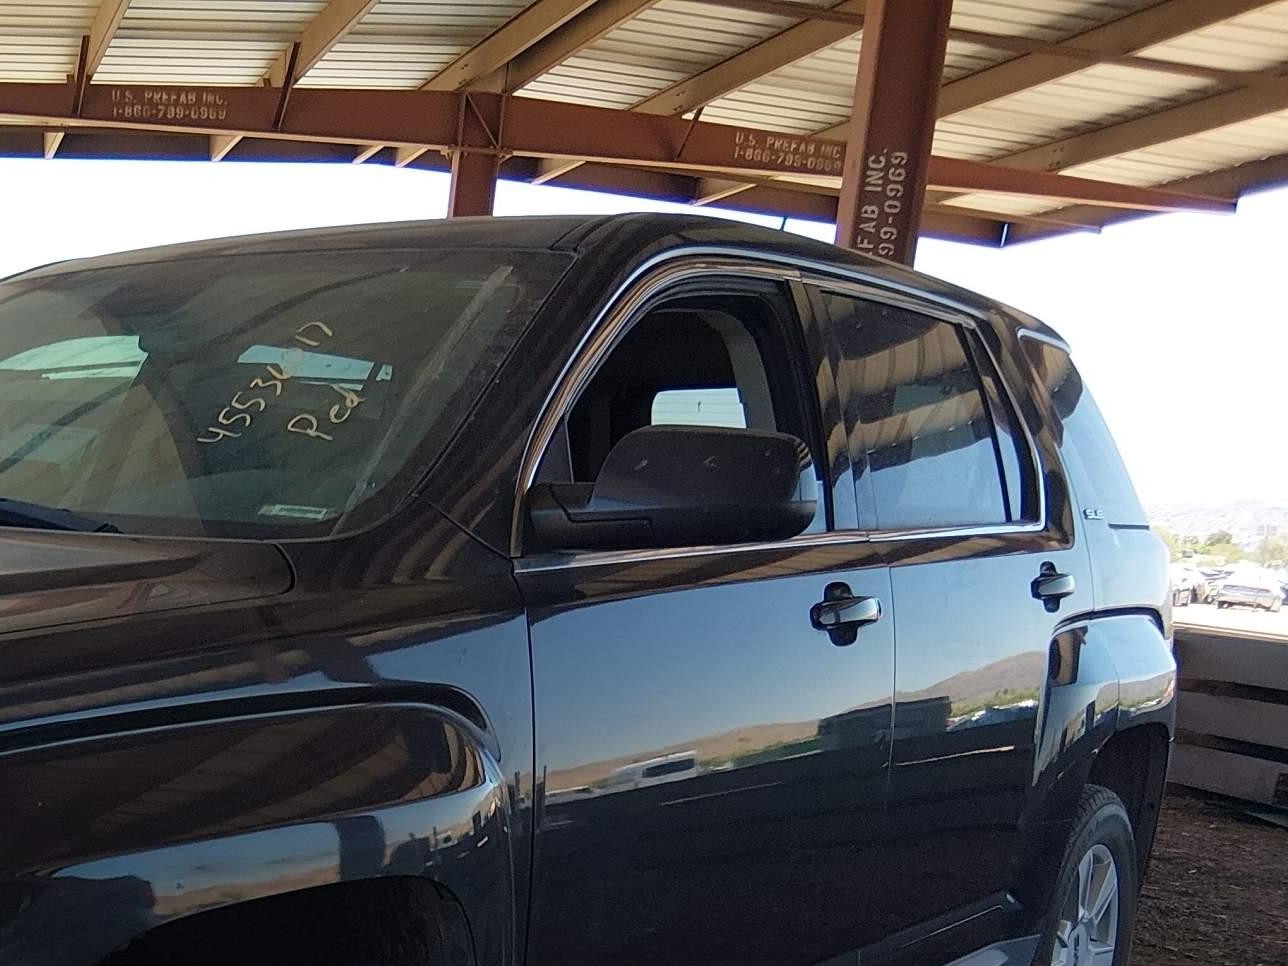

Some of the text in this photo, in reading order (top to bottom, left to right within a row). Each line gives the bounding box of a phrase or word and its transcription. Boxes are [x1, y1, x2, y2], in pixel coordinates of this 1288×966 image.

[110, 88, 229, 105] U.S. PREFAB INC.
[765, 136, 816, 155] PREFAB
[864, 147, 889, 193] INC.
